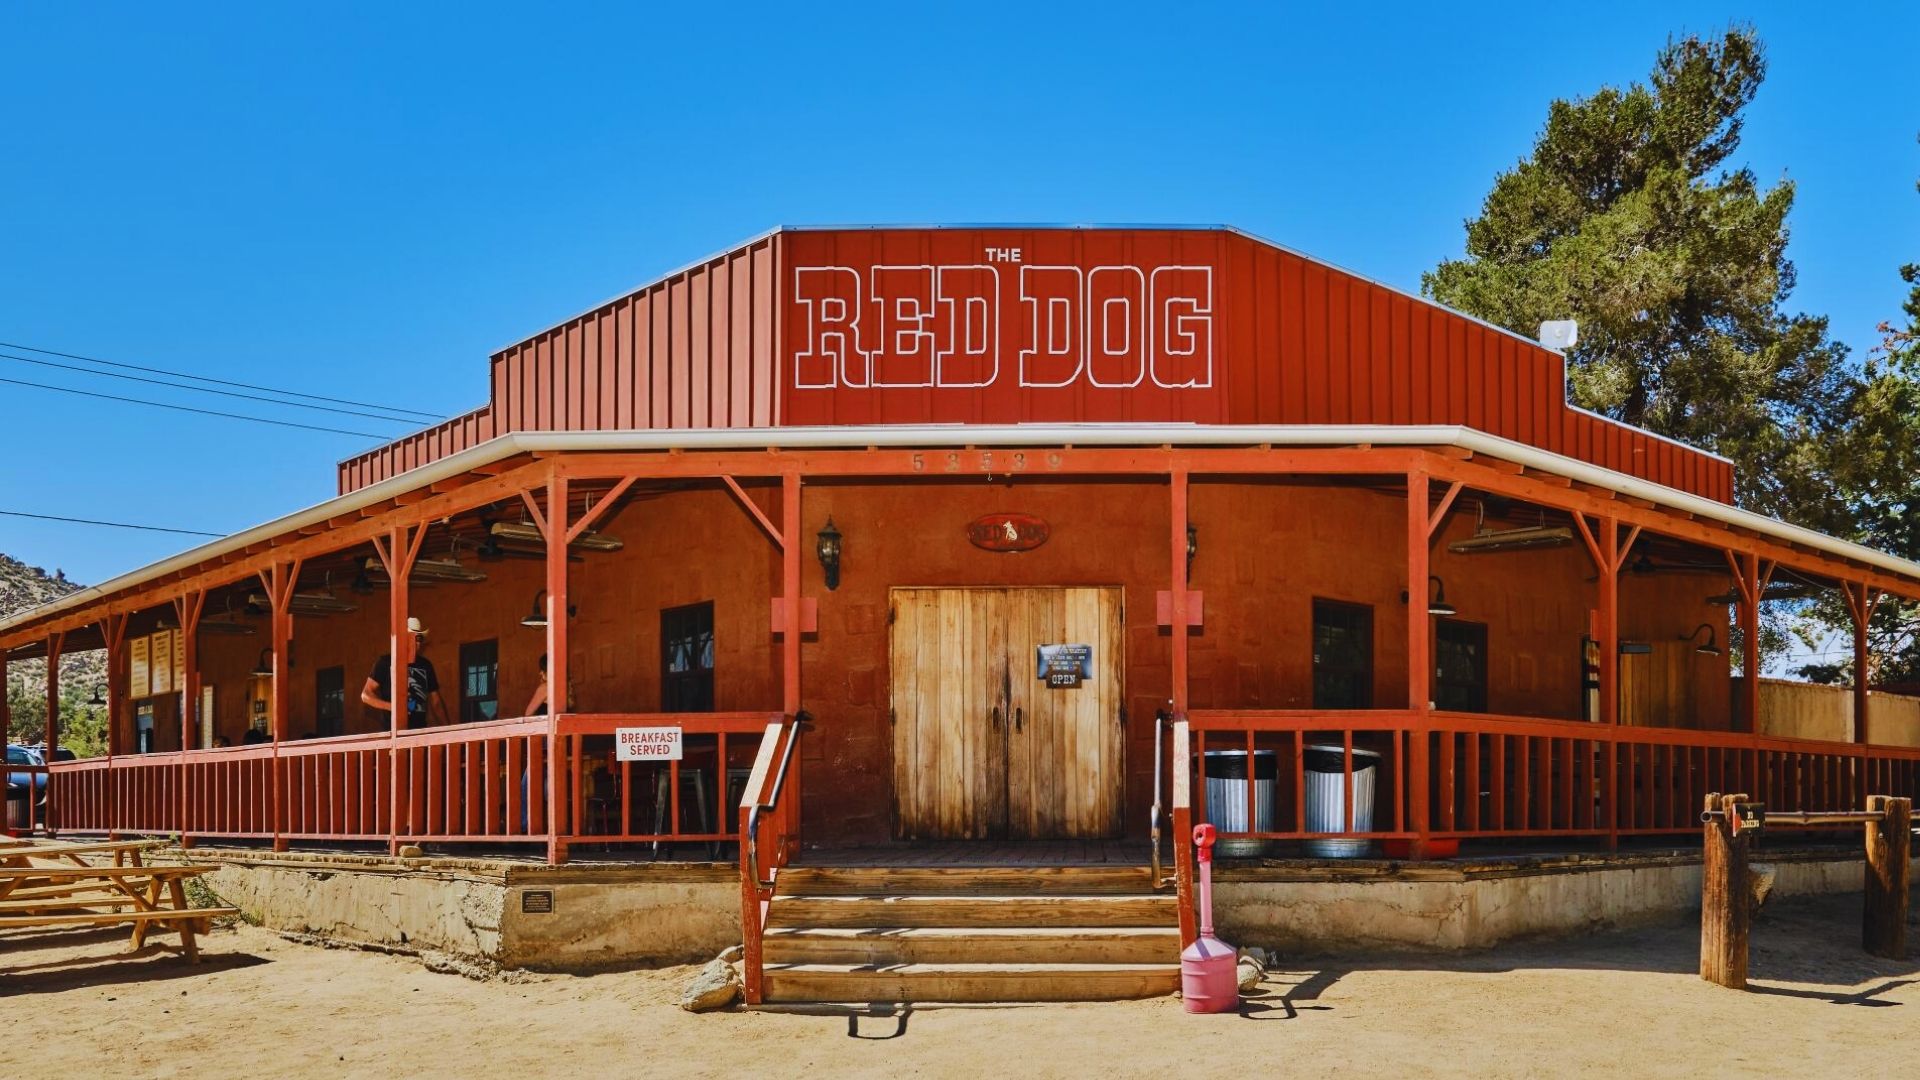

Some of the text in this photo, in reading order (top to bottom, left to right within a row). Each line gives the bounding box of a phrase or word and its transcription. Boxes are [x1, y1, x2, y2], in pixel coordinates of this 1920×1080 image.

[985, 248, 1022, 263] THE
[795, 265, 1212, 388] RED DOG
[1052, 674, 1076, 684] OPEN
[621, 732, 679, 744] BREAKFAST
[630, 744, 670, 755] SERVED
